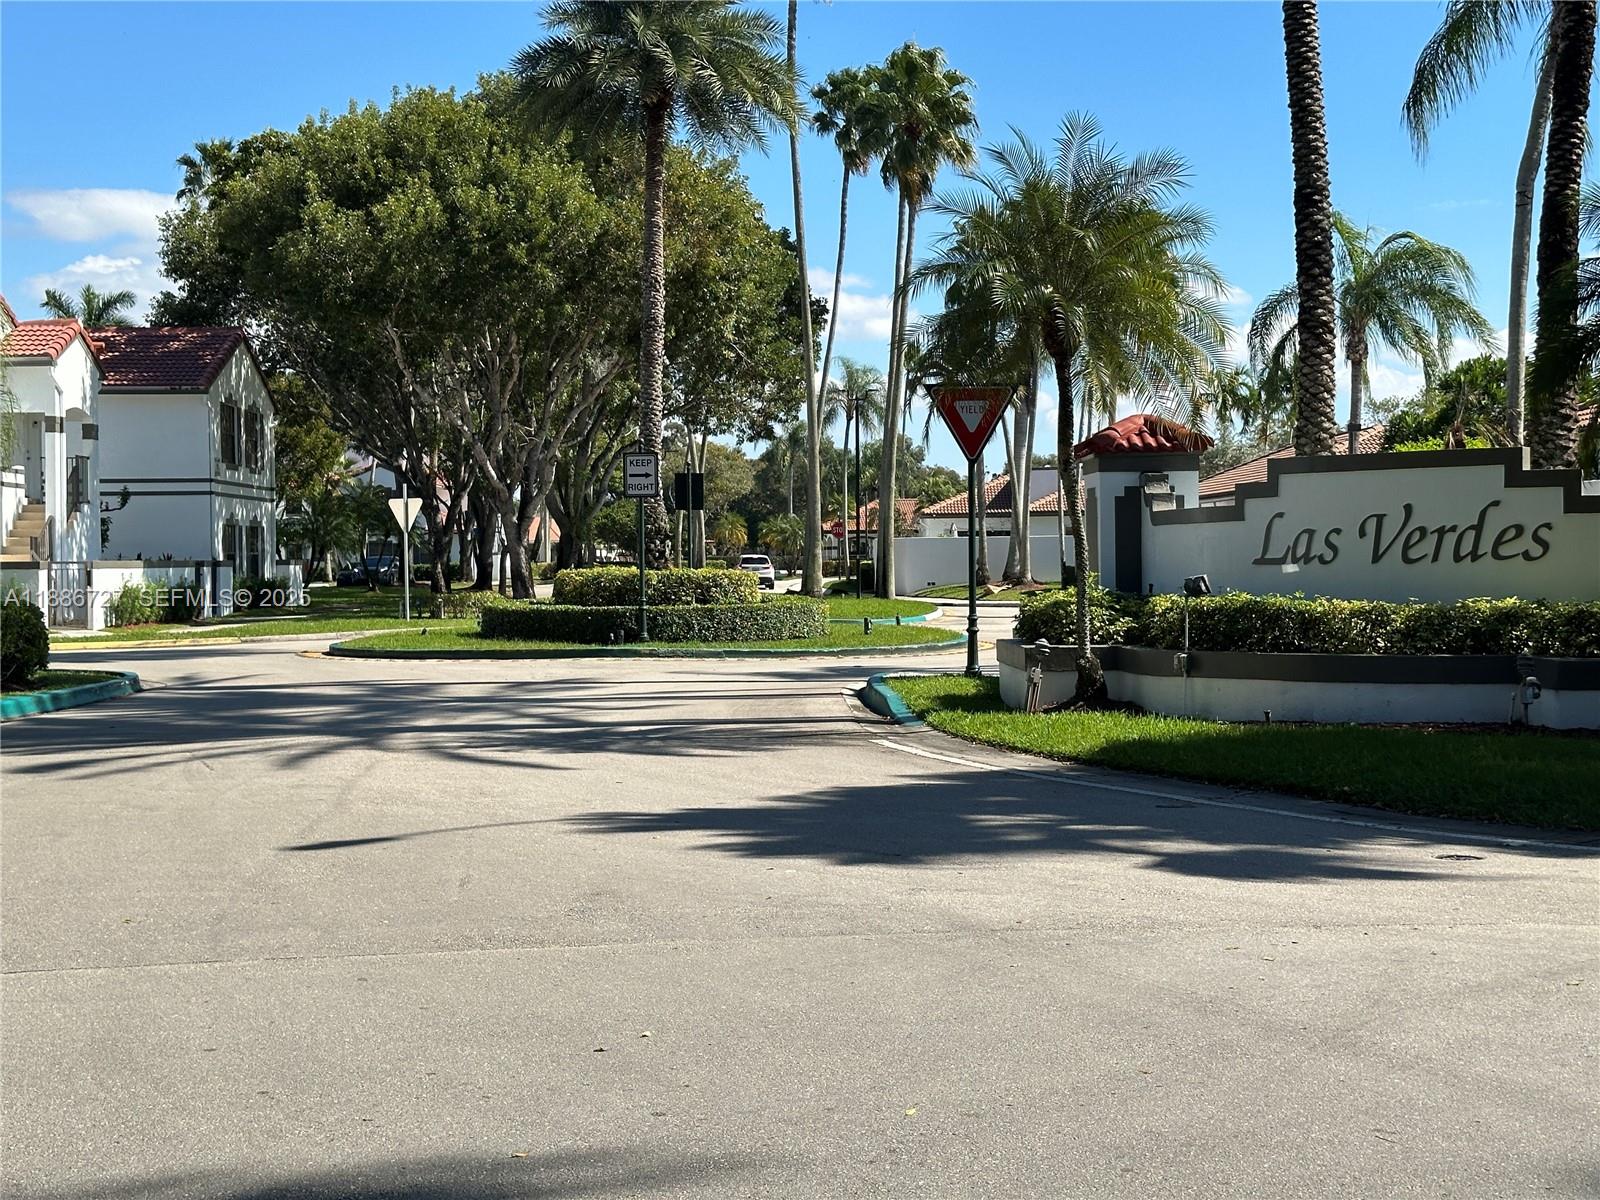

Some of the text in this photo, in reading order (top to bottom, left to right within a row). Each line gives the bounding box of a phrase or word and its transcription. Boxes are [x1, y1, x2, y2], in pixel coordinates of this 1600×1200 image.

[960, 405, 985, 414] YIELD
[629, 459, 653, 467] KEEP
[628, 483, 655, 491] RIGHT
[1251, 500, 1554, 565] Las Verdes
